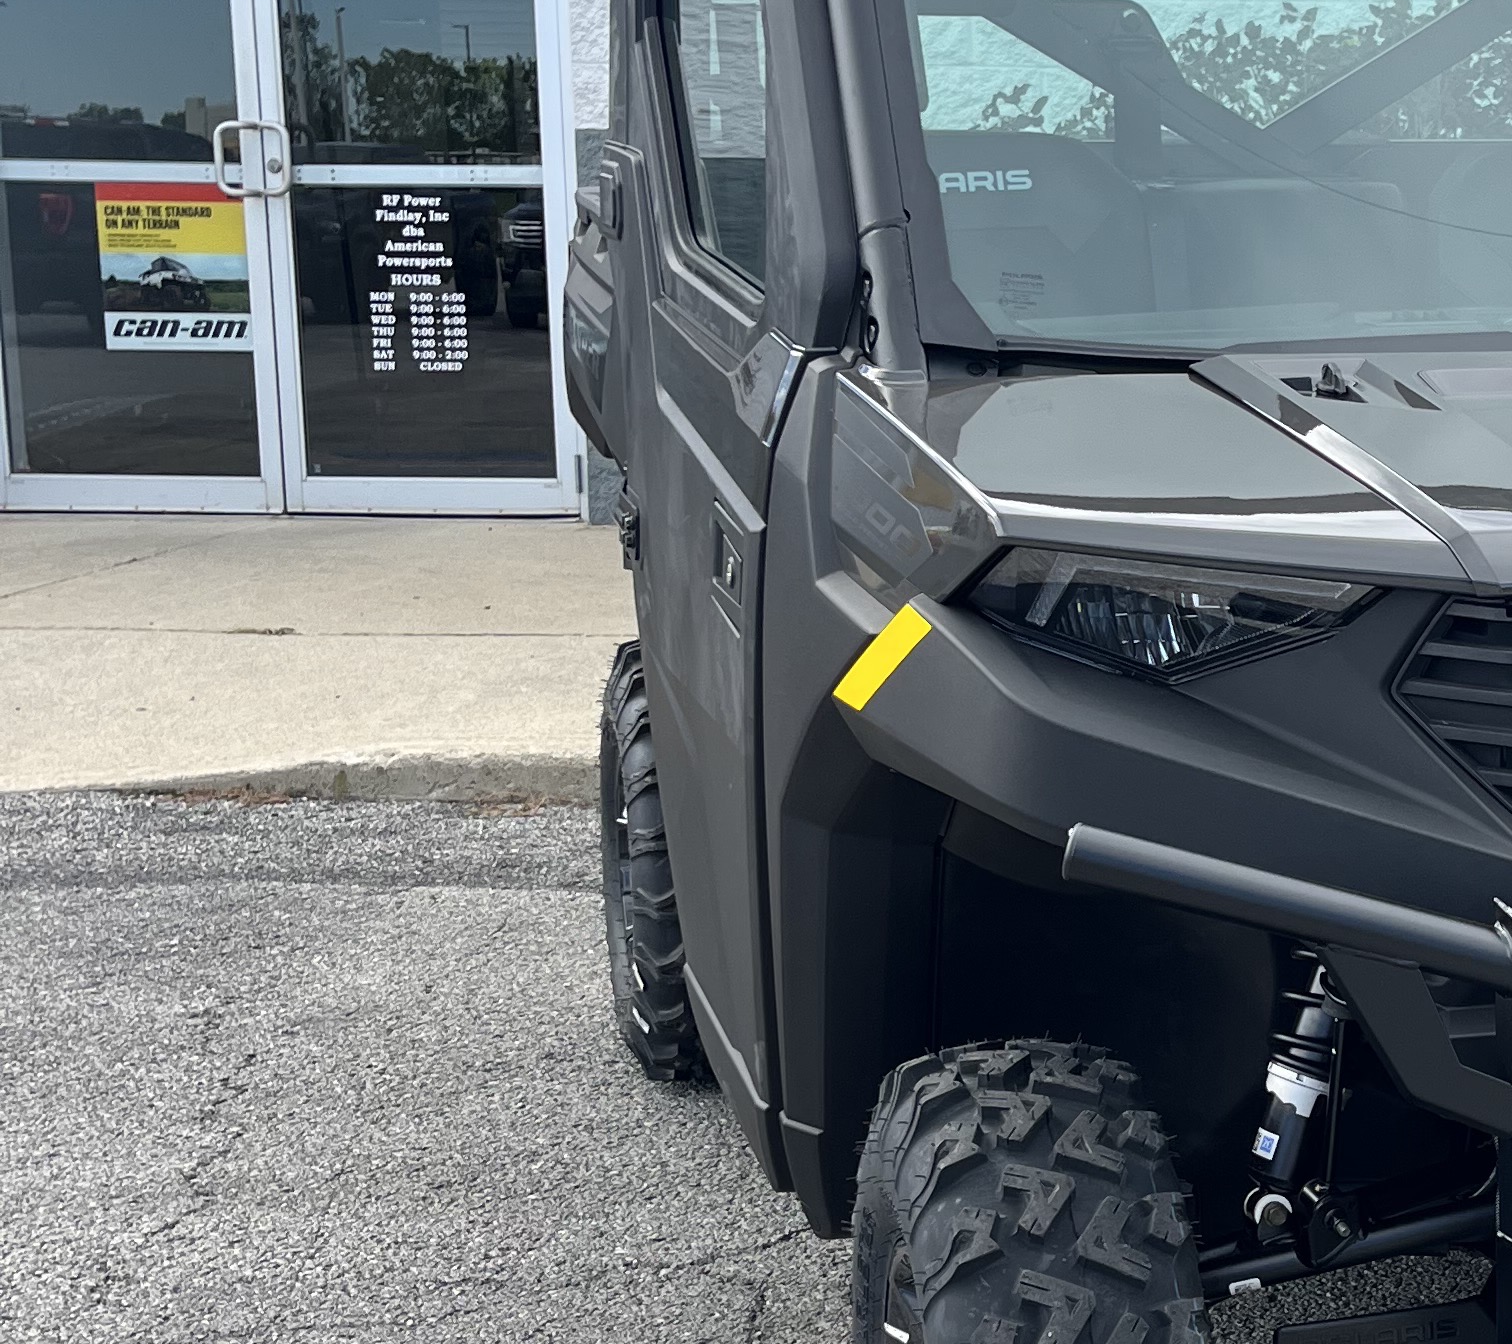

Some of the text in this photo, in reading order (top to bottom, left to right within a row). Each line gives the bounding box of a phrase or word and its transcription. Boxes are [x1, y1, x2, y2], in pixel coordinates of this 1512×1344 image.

[939, 169, 1033, 194] ARIS
[382, 194, 441, 207] RF Power
[146, 206, 162, 216] THE
[165, 206, 212, 218] STANDARD
[375, 209, 450, 224] Findlay, Inc
[105, 218, 180, 229] ON ANY TERRAIN
[402, 225, 425, 236] dba
[385, 240, 444, 251] American
[377, 255, 453, 269] Powersports
[391, 274, 441, 286] HOURS
[369, 291, 395, 302] MON
[409, 293, 433, 302] 9:00
[441, 293, 465, 302] 6:00
[369, 303, 393, 313] TUE
[410, 304, 434, 314] 9:00
[442, 304, 466, 314] 6:00
[370, 315, 396, 324] WED
[410, 316, 434, 325] 9:00
[443, 316, 467, 325] 6:00
[113, 318, 248, 339] can-am
[371, 326, 395, 336] THU
[411, 327, 435, 337] 9:00
[443, 327, 467, 337] 6:00
[372, 338, 392, 348] FRI
[411, 339, 436, 348] 9:00
[444, 339, 468, 348] 6:00
[373, 350, 395, 359] SAT
[412, 350, 436, 360] 9:00
[445, 350, 469, 360] 2:00
[373, 361, 463, 371] SUN CLOSED
